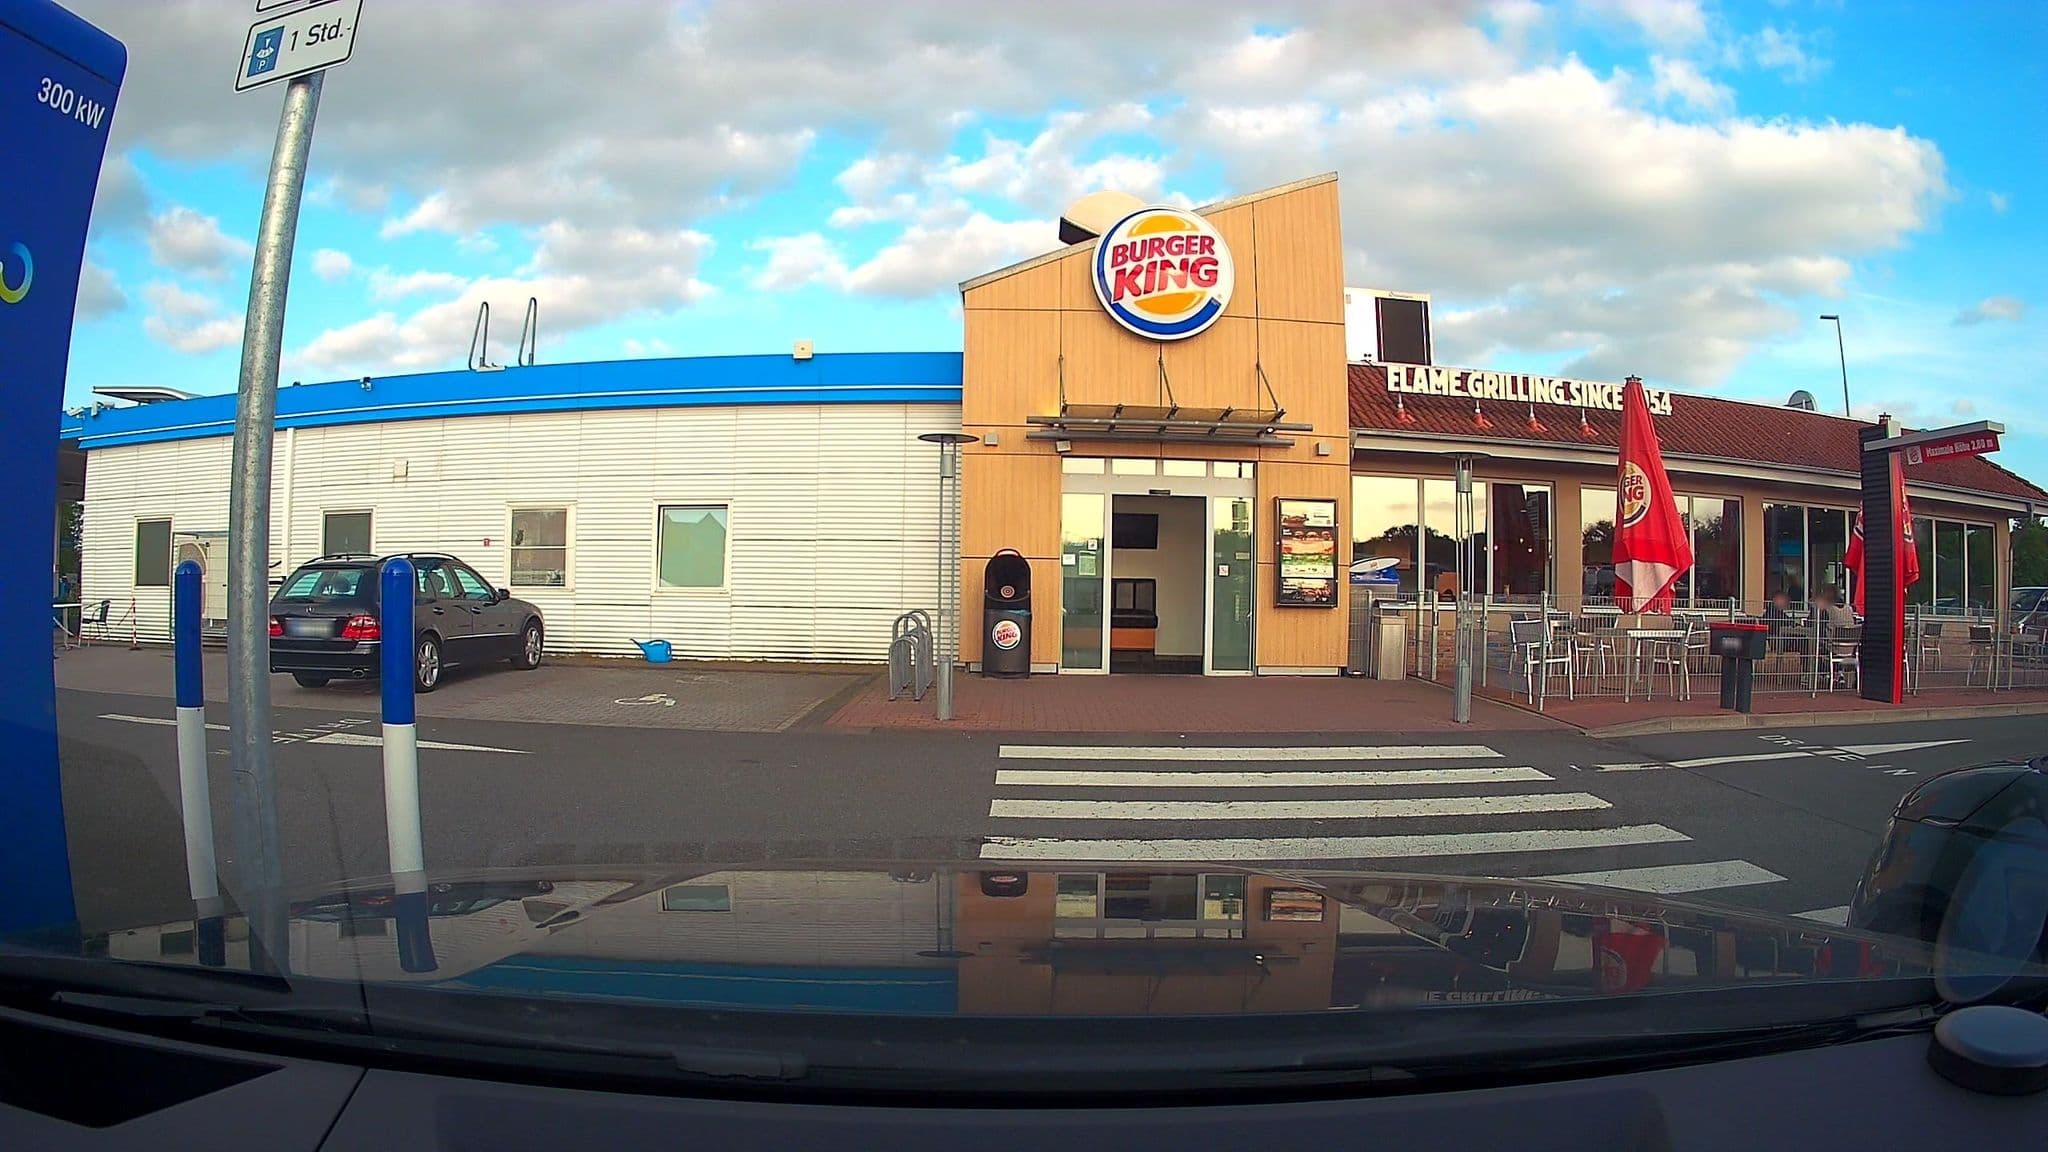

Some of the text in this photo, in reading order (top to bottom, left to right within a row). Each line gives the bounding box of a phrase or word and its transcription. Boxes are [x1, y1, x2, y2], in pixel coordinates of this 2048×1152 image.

[290, 17, 344, 52] 1 Std.
[37, 77, 106, 129] 300 kW
[1111, 235, 1215, 269] BURGER
[1113, 256, 1219, 302] KING
[1467, 370, 1566, 406] GRILLING
[1569, 379, 1624, 411] SINCE
[1644, 388, 1672, 416] 54
[1624, 474, 1643, 488] GER
[1624, 485, 1645, 502] NG
